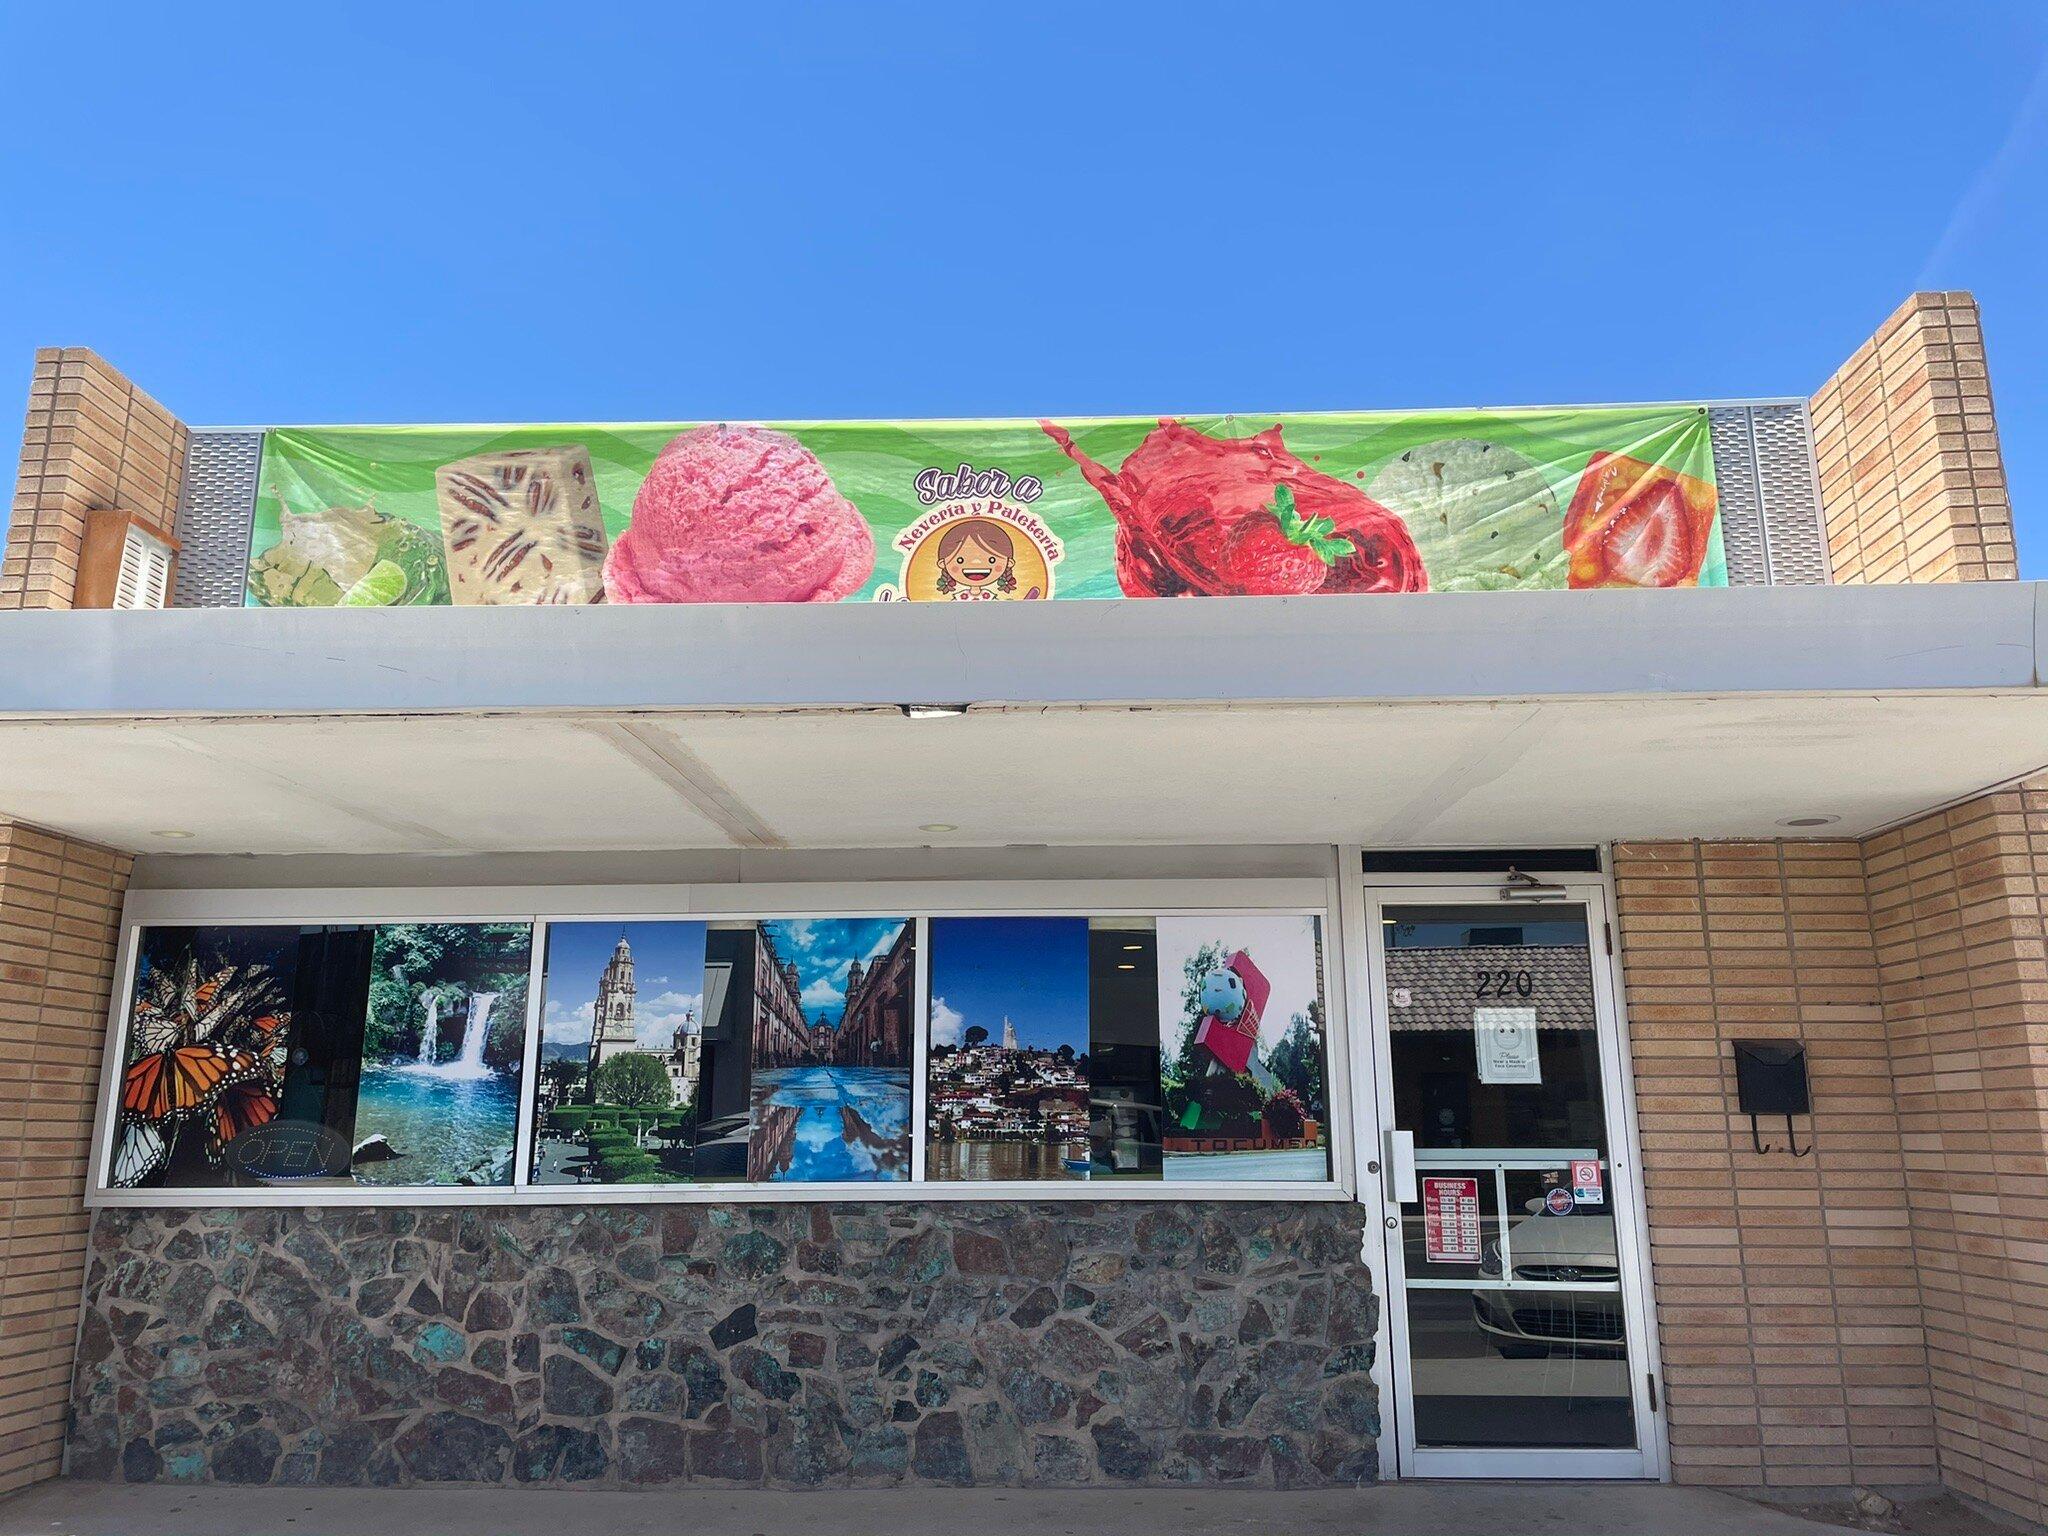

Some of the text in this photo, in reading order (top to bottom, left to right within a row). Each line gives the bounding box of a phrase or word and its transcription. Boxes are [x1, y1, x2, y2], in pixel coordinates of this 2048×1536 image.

[914, 463, 1043, 505] Sabor a
[898, 500, 1060, 562] Nevería y Paletería
[1476, 969, 1533, 999] 220
[237, 1138, 336, 1169] OPEN
[1433, 1182, 1467, 1190] BUSINESS
